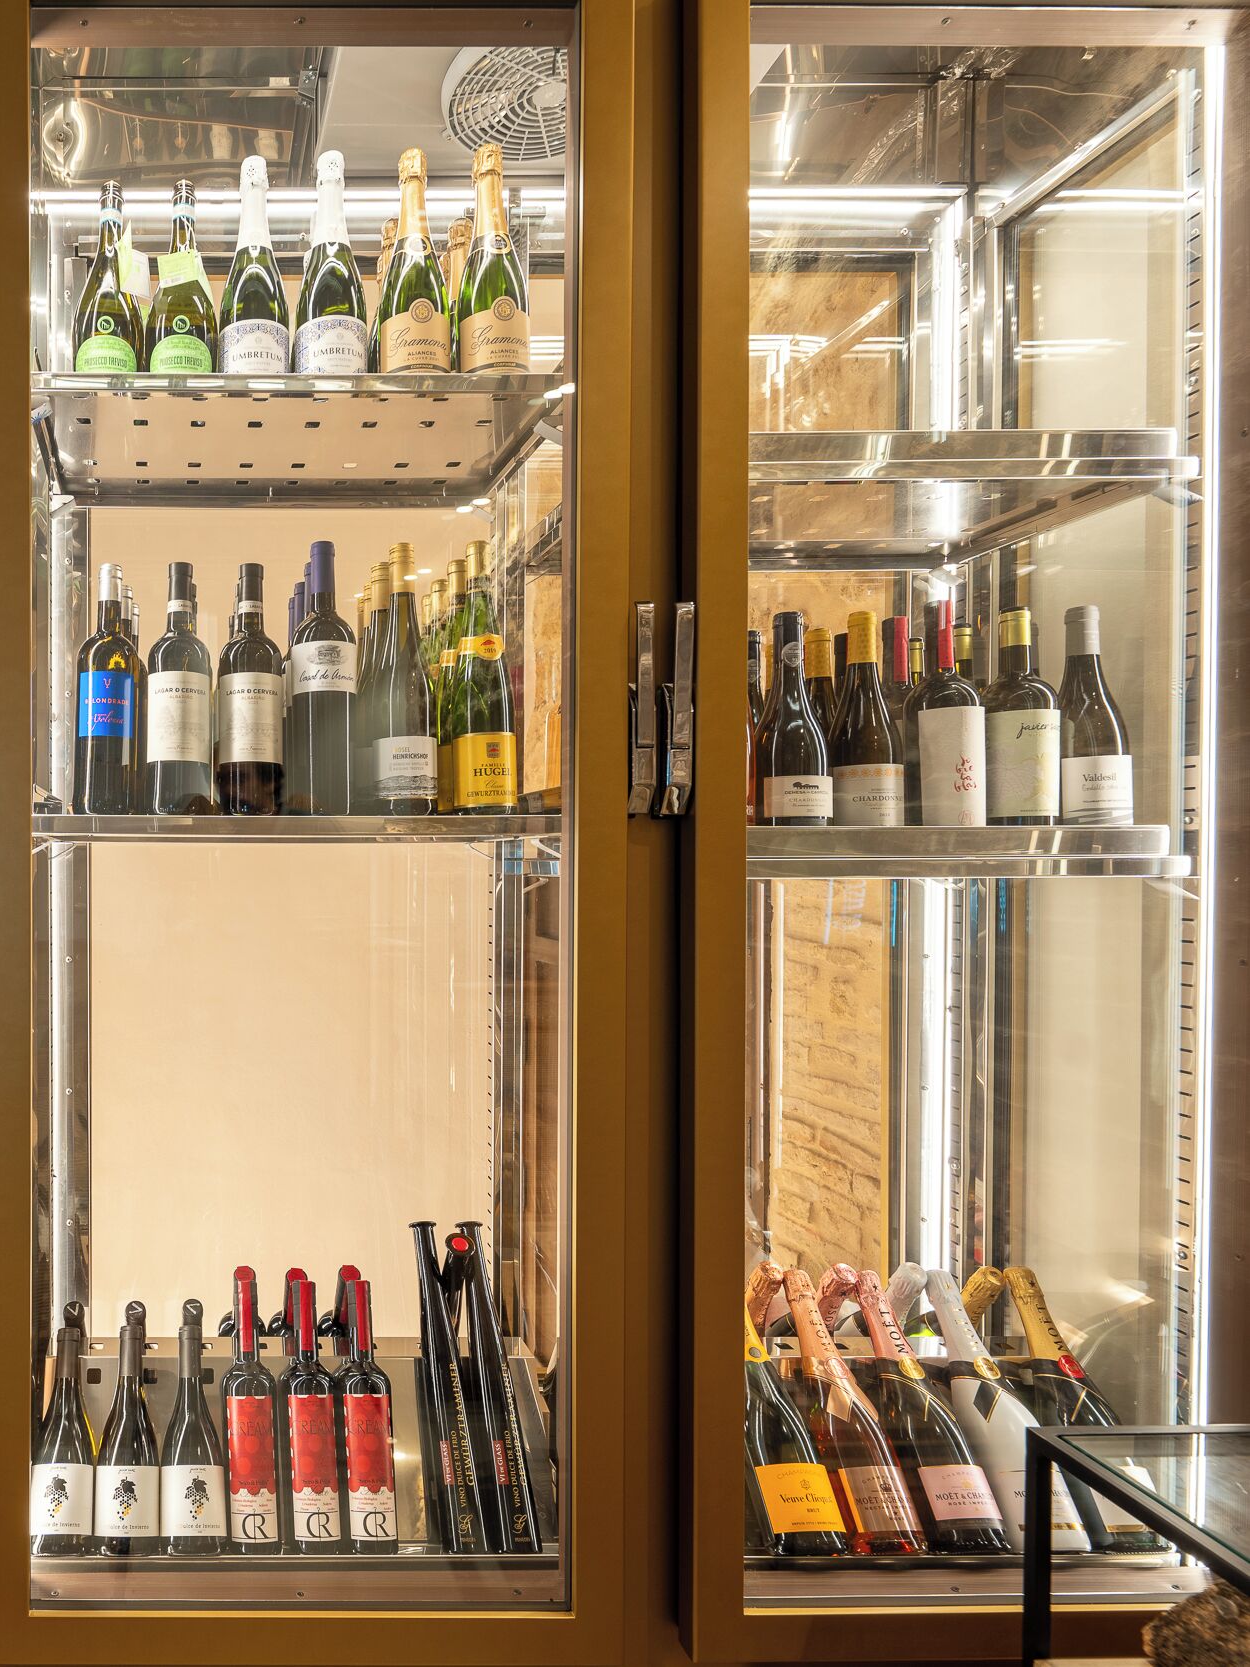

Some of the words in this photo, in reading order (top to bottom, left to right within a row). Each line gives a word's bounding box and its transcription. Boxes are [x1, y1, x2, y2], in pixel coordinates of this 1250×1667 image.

[232, 350, 283, 363] UMBRETUM
[313, 347, 363, 360] UMBRETUM
[154, 687, 174, 695] LAGAR
[181, 687, 207, 696] CERVERA
[252, 688, 279, 697] CERVERA
[1082, 772, 1117, 782] Valdesil
[879, 1307, 909, 1355] MOËT
[1036, 1303, 1068, 1352] MOËT
[291, 1420, 335, 1436] CREAM
[348, 1419, 389, 1435] CREAM
[450, 1430, 459, 1451] FRIO
[504, 1430, 512, 1451] FRIO
[441, 1442, 450, 1467] GLASS
[453, 1453, 460, 1462] DE
[496, 1442, 505, 1467] GLASS
[507, 1453, 515, 1463] DE
[455, 1463, 464, 1486] DULCE
[509, 1463, 518, 1486] DULCE
[457, 1487, 466, 1508] VINO
[511, 1487, 521, 1508] VINO
[779, 1494, 805, 1504] Veuve
[855, 1496, 879, 1505] MOËT
[935, 1490, 960, 1501] MOËT
[960, 1493, 967, 1501] &
[1013, 1490, 1027, 1499] MO
